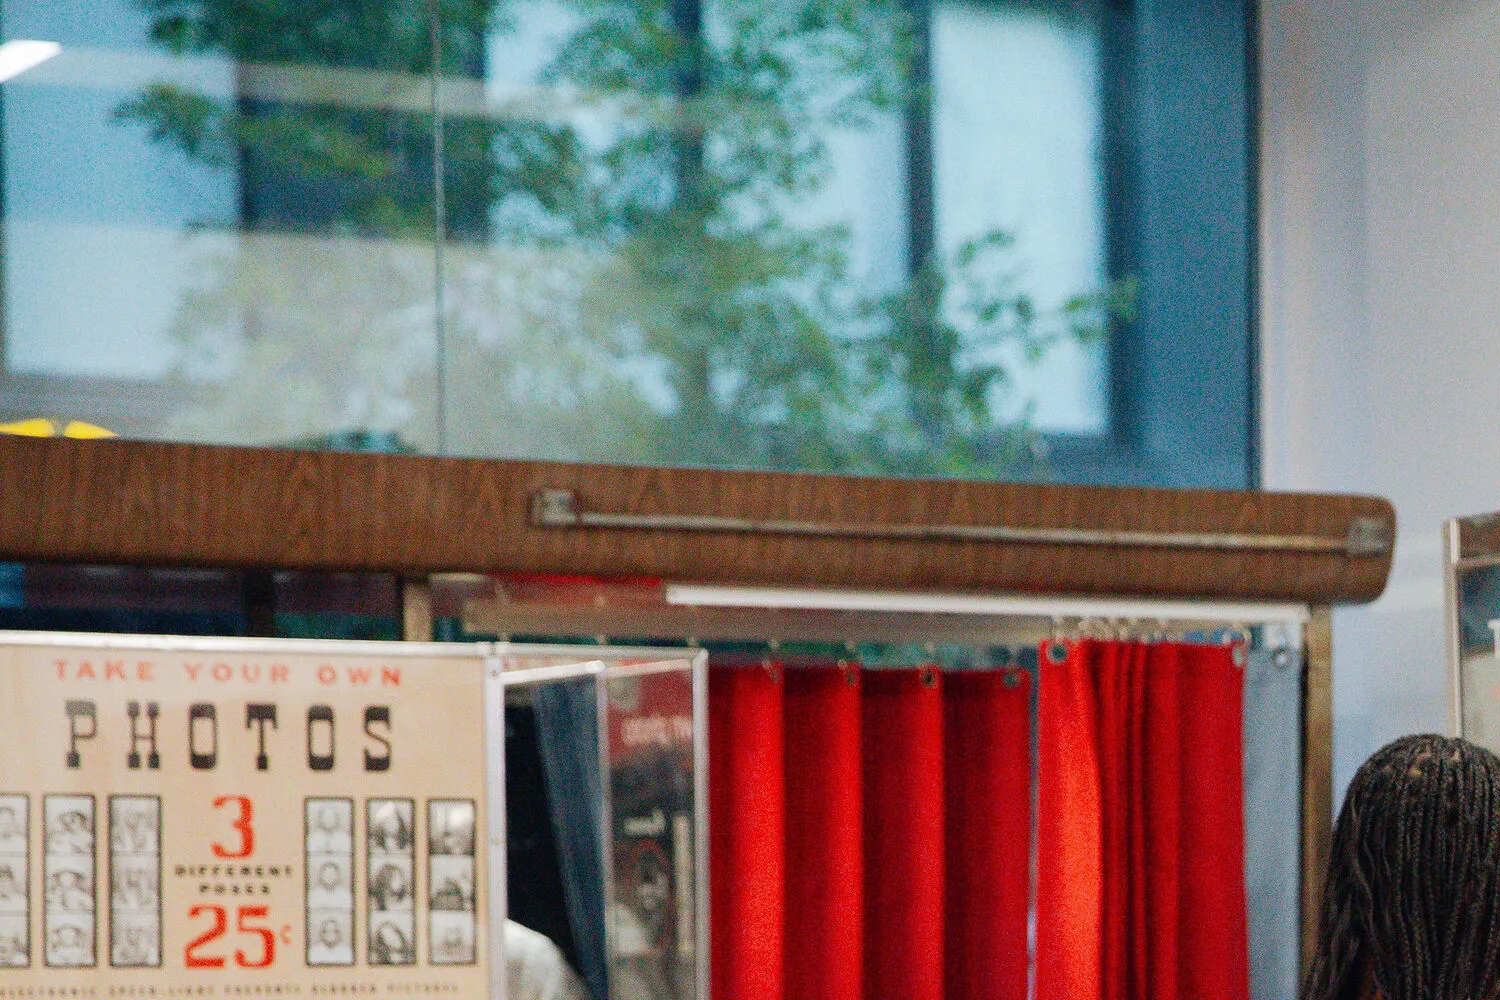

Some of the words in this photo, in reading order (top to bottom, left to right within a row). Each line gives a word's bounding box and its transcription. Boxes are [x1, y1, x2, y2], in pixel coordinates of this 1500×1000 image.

[53, 658, 155, 682] TAKE
[183, 662, 289, 684] YOUR
[316, 664, 402, 686] OWN
[63, 699, 393, 771] PHOTOS
[210, 795, 256, 859] 3
